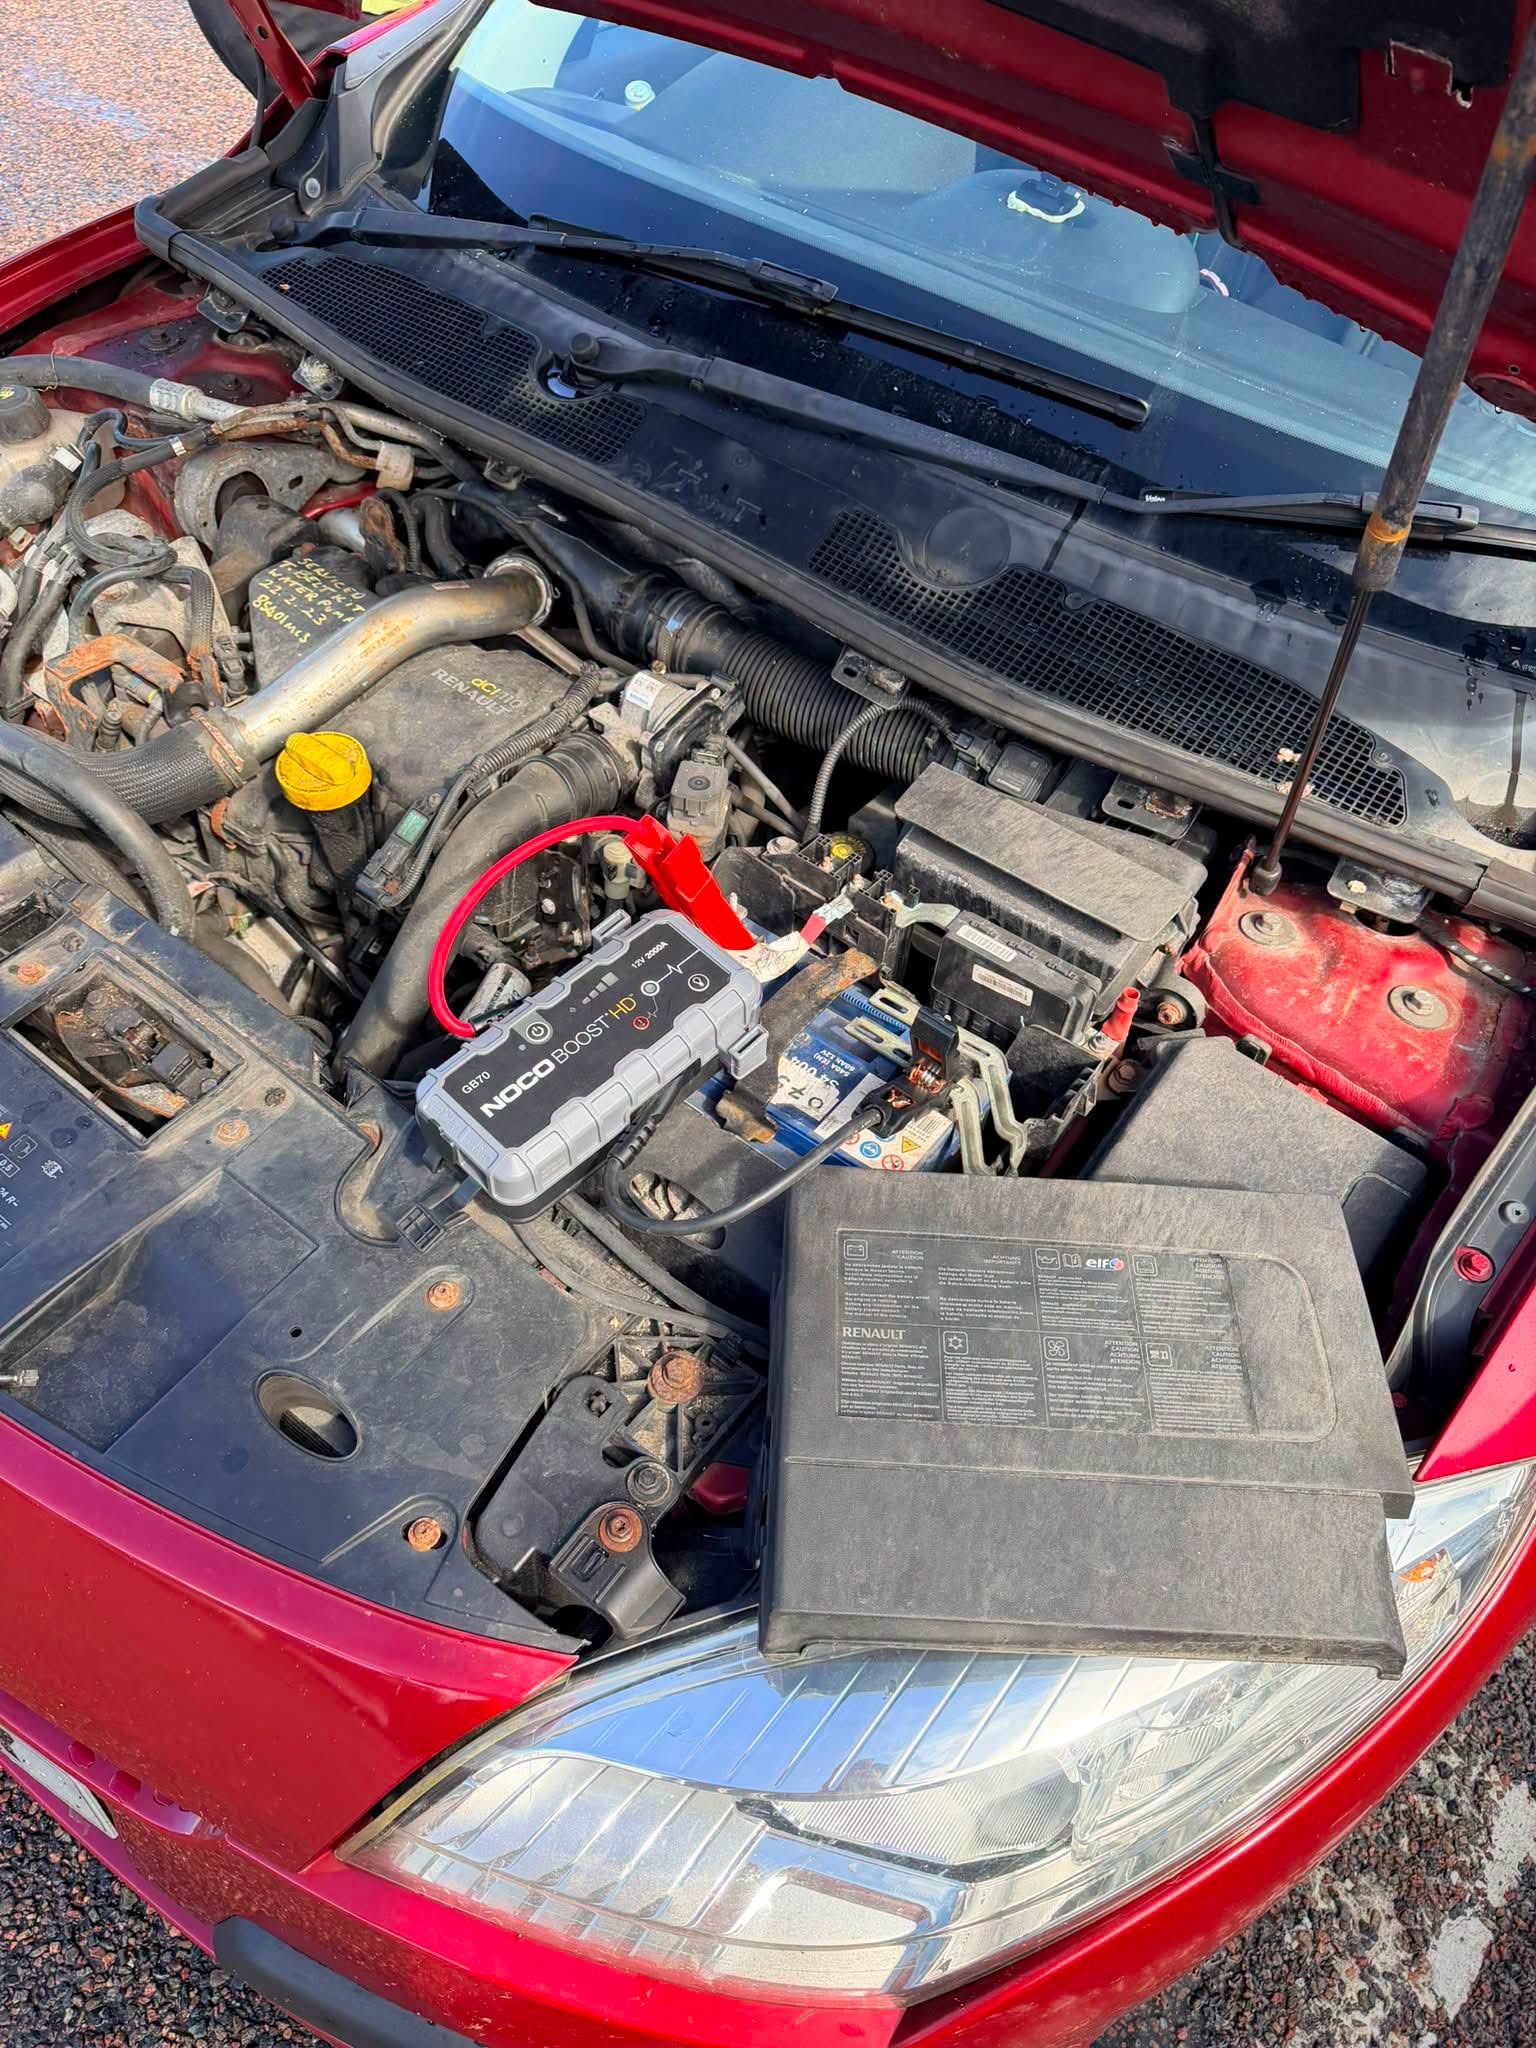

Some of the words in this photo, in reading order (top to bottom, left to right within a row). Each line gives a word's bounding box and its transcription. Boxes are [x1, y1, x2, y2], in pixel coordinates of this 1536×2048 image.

[269, 569, 319, 602] WATER
[298, 558, 366, 599] SERVICED
[331, 594, 365, 612] KIT
[431, 668, 512, 714] RENAULT
[631, 956, 646, 969] 12V
[645, 941, 669, 960] 2000A
[608, 996, 638, 1020] HD
[461, 1071, 491, 1094] GB70
[1085, 1258, 1111, 1269] elf
[842, 1327, 907, 1340] RENAULT
